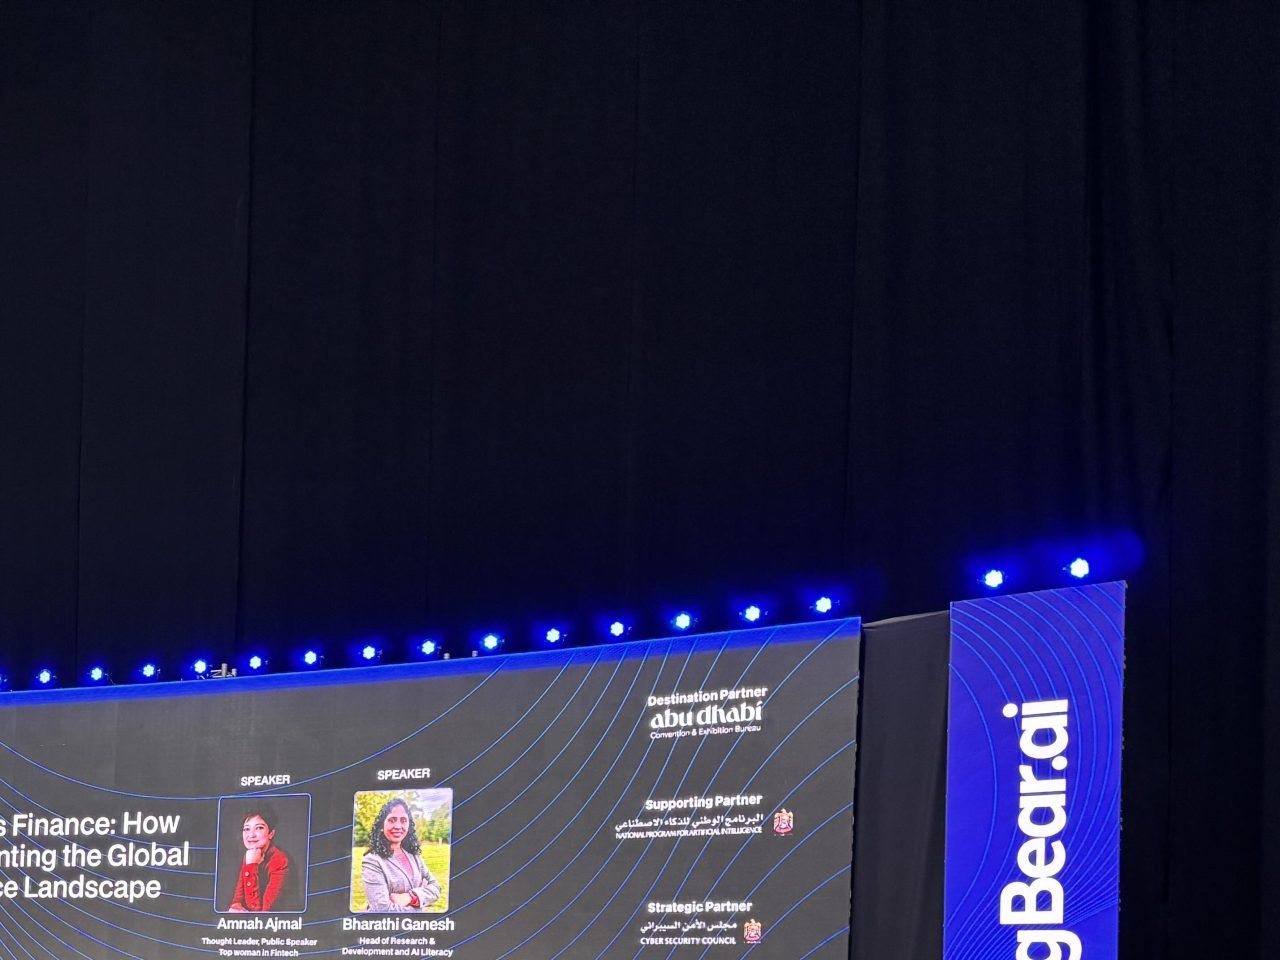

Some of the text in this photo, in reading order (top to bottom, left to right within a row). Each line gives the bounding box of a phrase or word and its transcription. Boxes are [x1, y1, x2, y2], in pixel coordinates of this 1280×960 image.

[648, 687, 768, 706] Destination Partner
[650, 701, 762, 728] abu dhabi
[650, 729, 690, 738] Convention
[699, 726, 733, 735] Exhibition
[241, 775, 290, 786] SPEAKER
[377, 768, 430, 780] SPEAKER
[646, 795, 762, 810] Supporting Partner
[13, 813, 115, 836] Finance:
[123, 812, 180, 834] How
[63, 845, 101, 867] the
[108, 842, 189, 867] Global
[25, 875, 161, 902] Landscape
[648, 901, 752, 914] Strategic Partner
[217, 917, 302, 932] Amnah Ajmal
[343, 918, 454, 930] Bharathi Ganesh
[201, 938, 232, 946] Thought
[234, 938, 260, 946] Leader,
[286, 938, 317, 946] Speaker
[421, 948, 453, 957] Literacy
